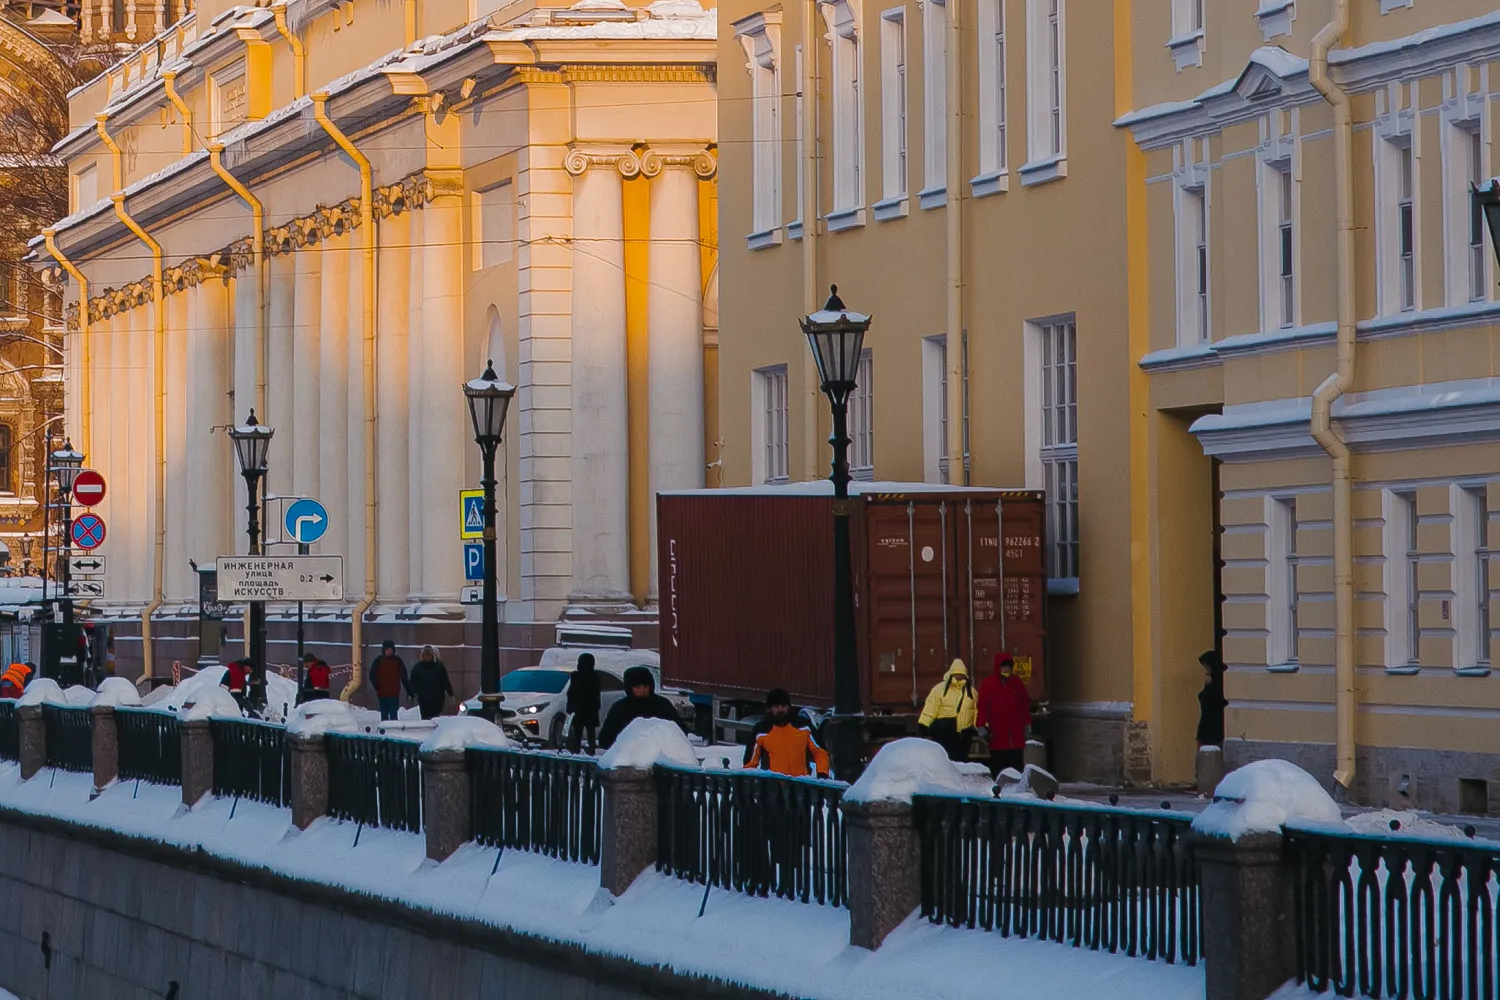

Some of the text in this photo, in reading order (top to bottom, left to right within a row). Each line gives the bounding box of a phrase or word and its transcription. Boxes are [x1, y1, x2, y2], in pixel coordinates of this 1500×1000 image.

[1005, 536, 1032, 547] 962266
[224, 562, 294, 570] ИНЖЕНЕРНАЯ
[469, 548, 480, 576] P
[245, 570, 273, 578] улица
[234, 587, 284, 596] ИСКУССТВ
